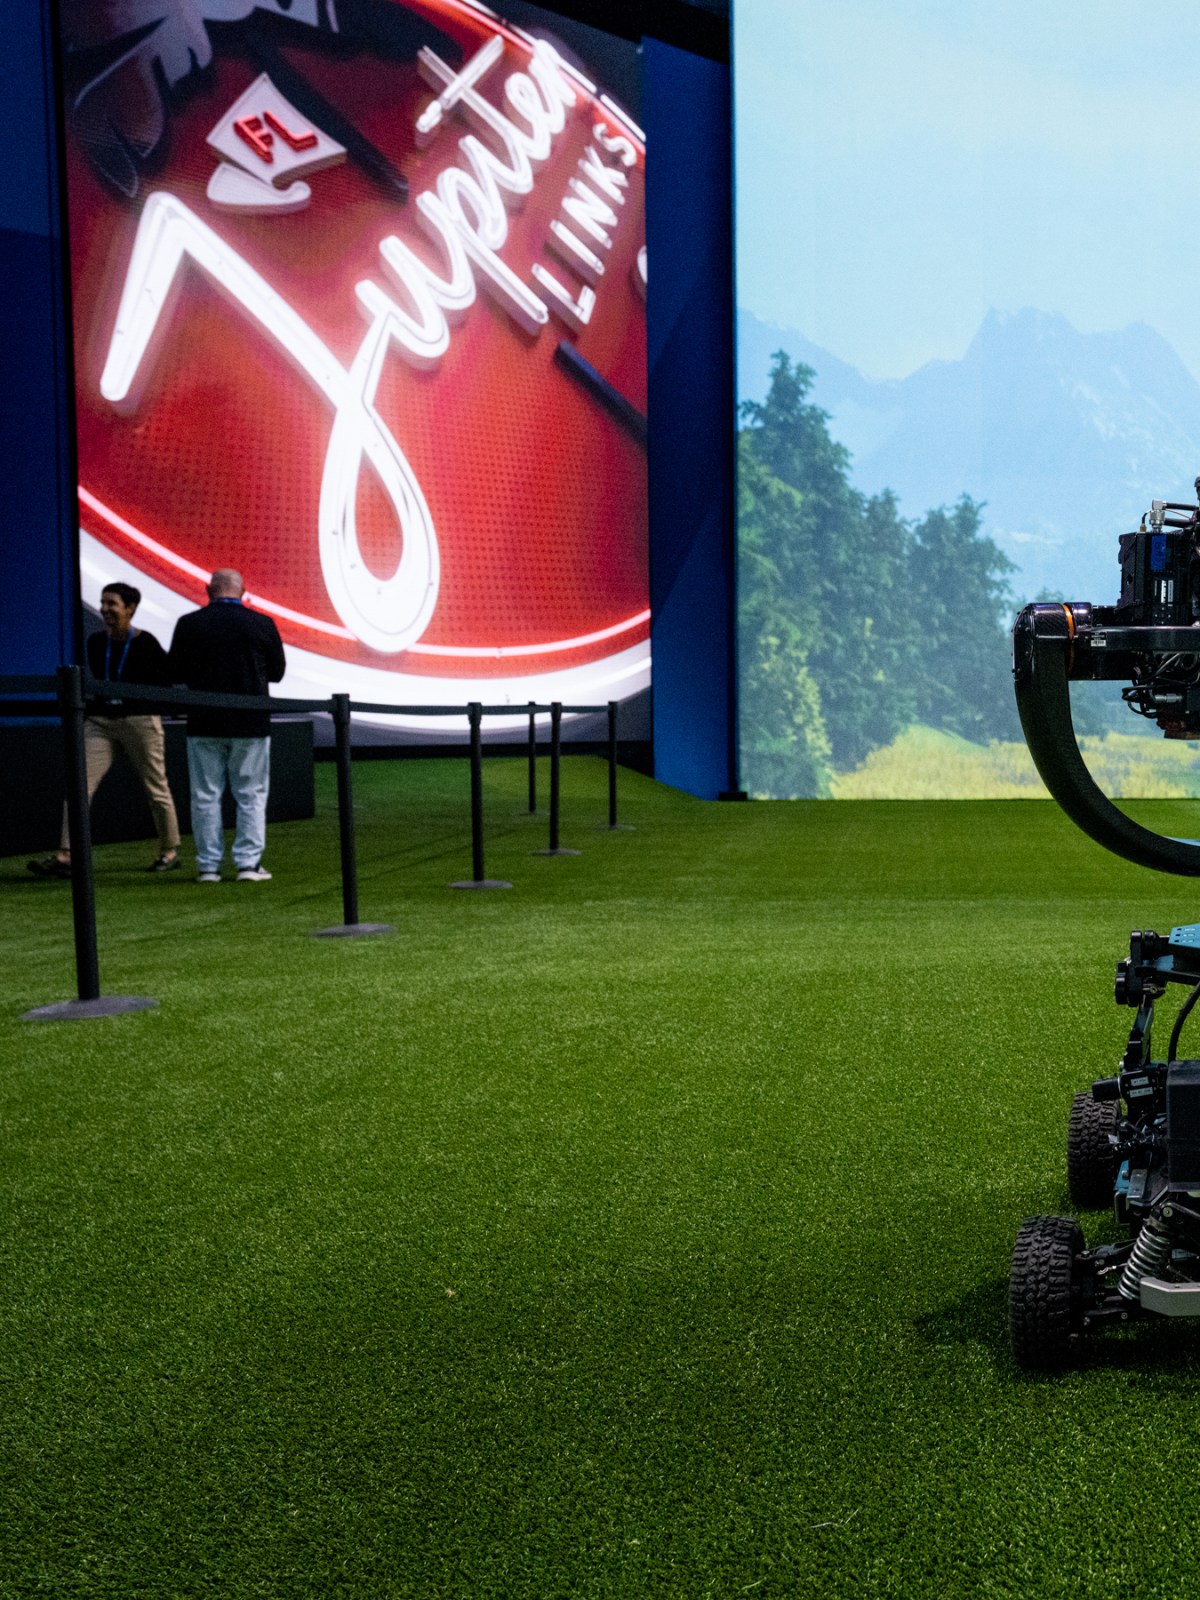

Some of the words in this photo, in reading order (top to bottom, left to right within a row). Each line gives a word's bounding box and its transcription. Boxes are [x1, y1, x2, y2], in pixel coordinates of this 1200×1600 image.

[233, 111, 318, 165] FL
[531, 123, 637, 325] LINKS
[101, 35, 576, 652] Jupiter
